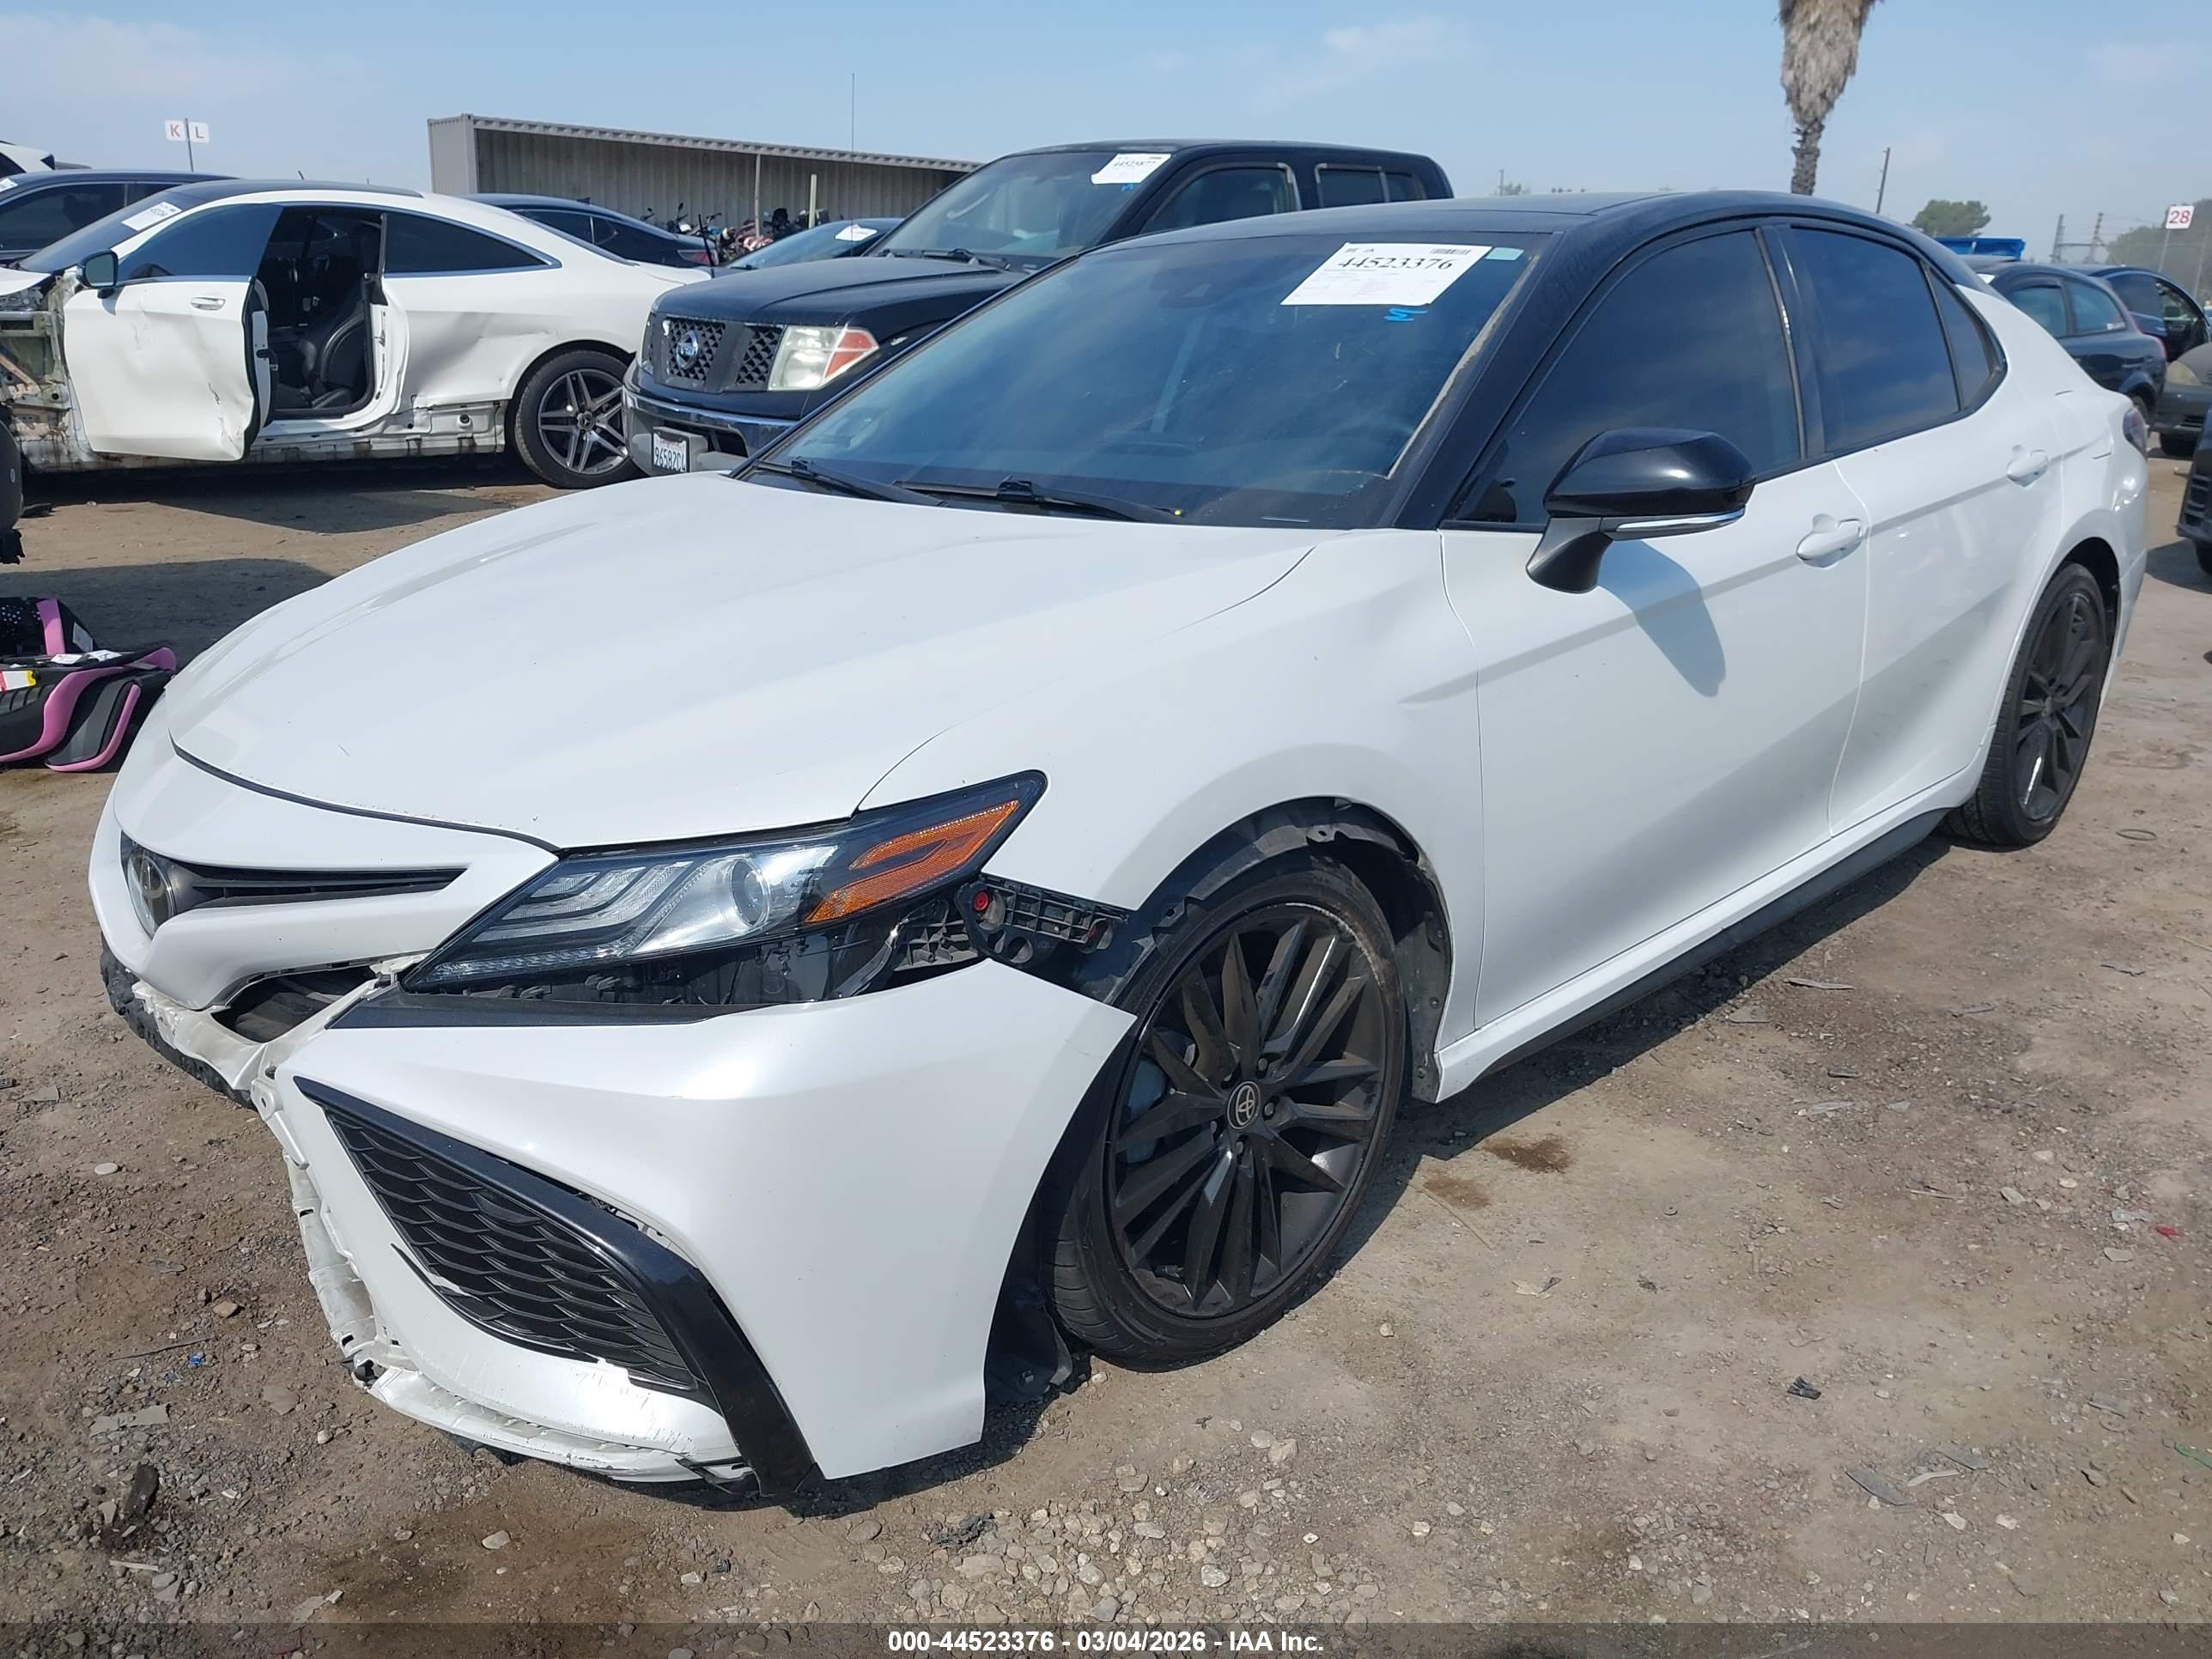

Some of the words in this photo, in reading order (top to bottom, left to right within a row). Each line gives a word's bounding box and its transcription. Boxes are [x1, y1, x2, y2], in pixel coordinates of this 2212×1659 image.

[170, 124, 180, 137] K
[195, 125, 205, 139] L
[2169, 210, 2191, 224] 28
[1337, 257, 1457, 269] 44523376
